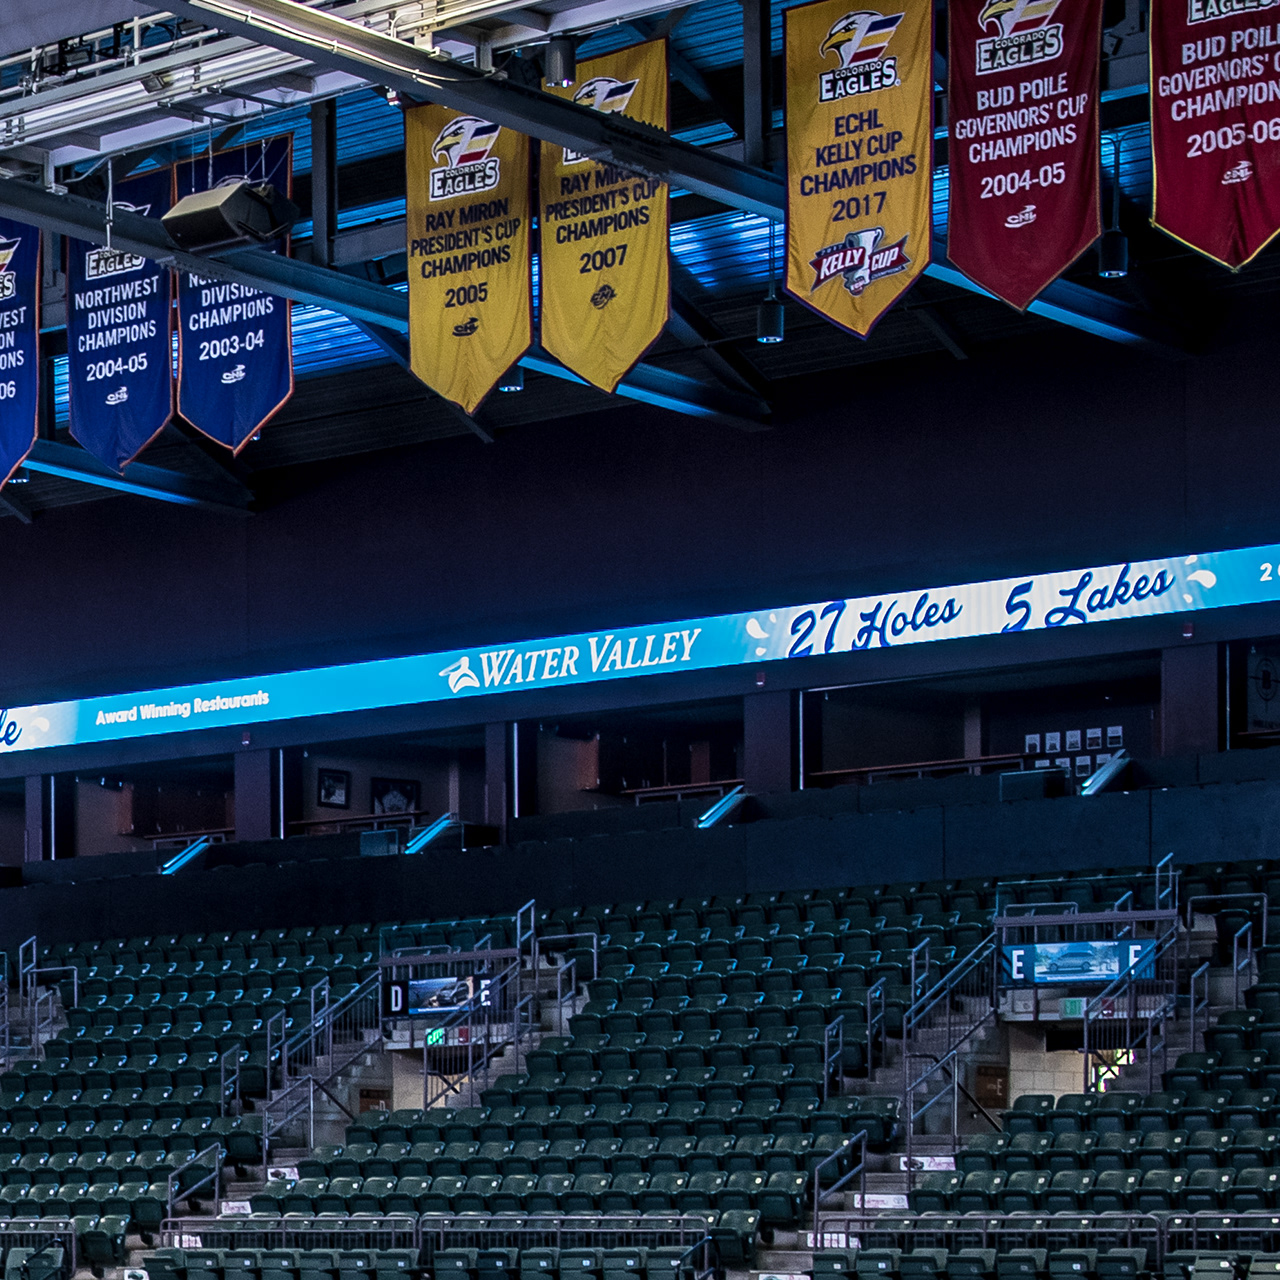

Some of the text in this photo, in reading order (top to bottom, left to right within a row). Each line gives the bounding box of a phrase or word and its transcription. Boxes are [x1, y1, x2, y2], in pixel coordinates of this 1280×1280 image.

[978, 26, 1061, 73] EAGLES
[995, 30, 1045, 50] COLORADO
[1182, 24, 1280, 65] BUD POIL
[821, 58, 897, 100] EAGLES
[835, 61, 883, 80] COLORADO
[1159, 53, 1269, 97] GOVERNORS'
[977, 73, 1069, 111] BUD POILE
[834, 108, 883, 138] ECHL
[955, 94, 1088, 140] GOVERNORS' CUP
[815, 131, 903, 167] KELLY CUP
[968, 124, 1077, 165] CHAMPIONS
[1187, 118, 1280, 158] 2005-06
[432, 160, 498, 197] EAGLES
[446, 163, 486, 178] COLORADO
[561, 172, 591, 195] RAY
[799, 154, 917, 197] CHAMPIONS
[980, 162, 1065, 199] 2004-05
[426, 198, 509, 232] RAY MIRON
[545, 179, 660, 222] PRESIDENT'S CUP
[832, 192, 887, 223] 2017
[411, 218, 521, 256] PRESIDENT'S CUP
[556, 206, 649, 244] CHAMPIONS
[421, 244, 511, 279] CHAMPIONS
[579, 244, 628, 274] 2007
[820, 248, 863, 279] KELLY
[871, 247, 899, 271] CUP
[74, 276, 159, 311] NORTHWEST
[445, 282, 488, 308] 2005
[88, 301, 147, 329] DIVISION
[189, 297, 273, 331] CHAMPIONS
[77, 321, 156, 352] CHAMPIONS
[199, 330, 264, 360] 2003-04
[86, 353, 148, 382] 2004-05
[789, 562, 1176, 657] 27 Holes 5 Lakes
[477, 629, 702, 689] WATER VALLEY
[96, 690, 270, 727] Award Winning Restaurants
[1012, 950, 1024, 979] E
[391, 985, 402, 1011] D
